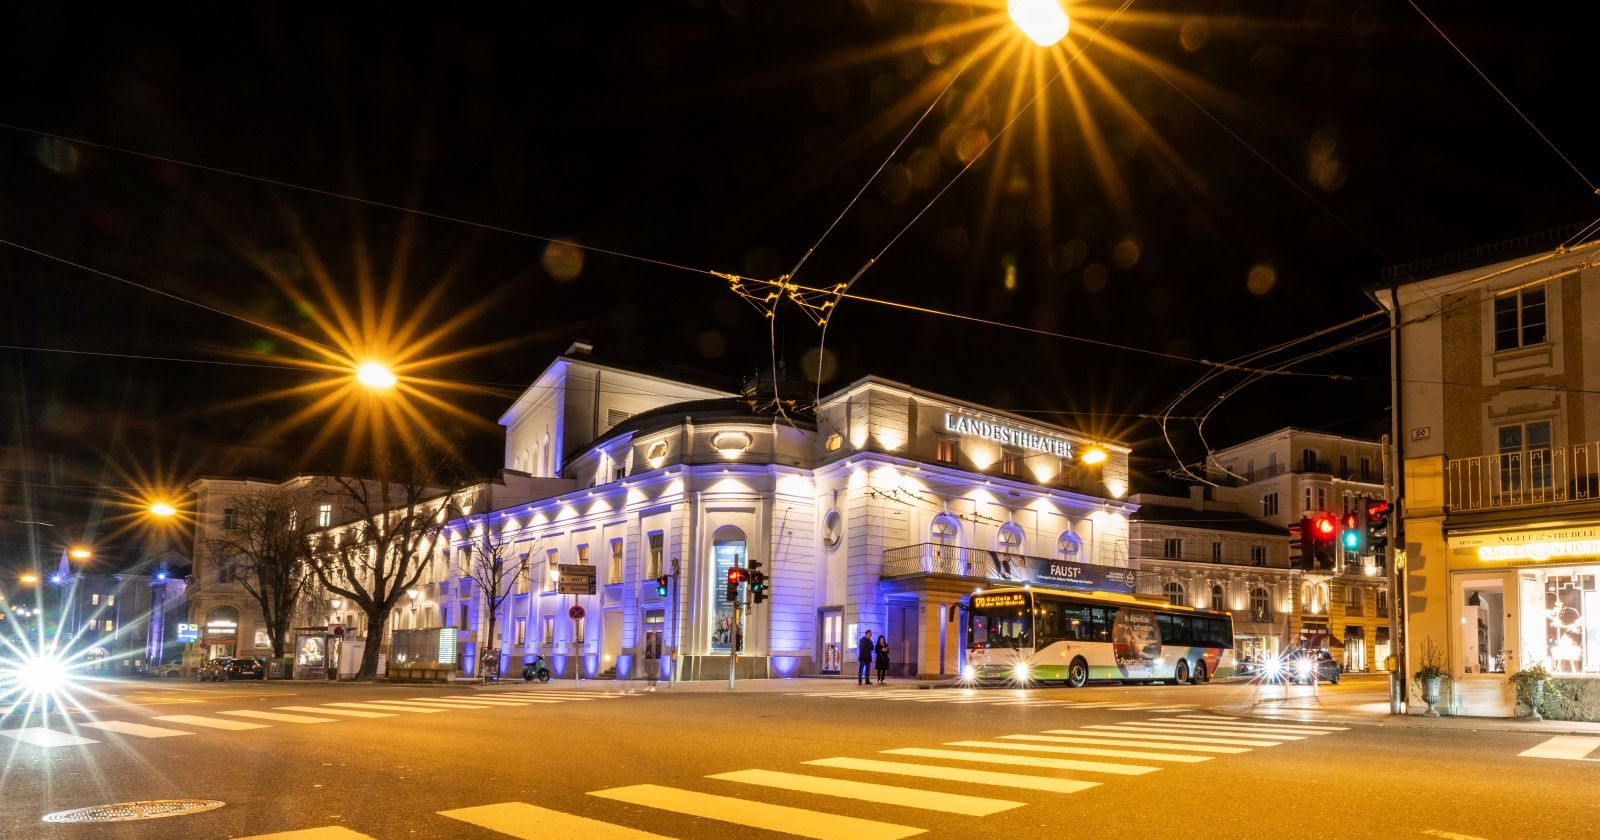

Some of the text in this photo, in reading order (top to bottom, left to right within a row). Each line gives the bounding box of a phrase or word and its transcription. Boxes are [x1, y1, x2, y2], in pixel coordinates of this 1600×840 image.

[945, 412, 1074, 459] LANDESTHEATER
[1415, 429, 1426, 437] 20
[178, 623, 189, 634] P
